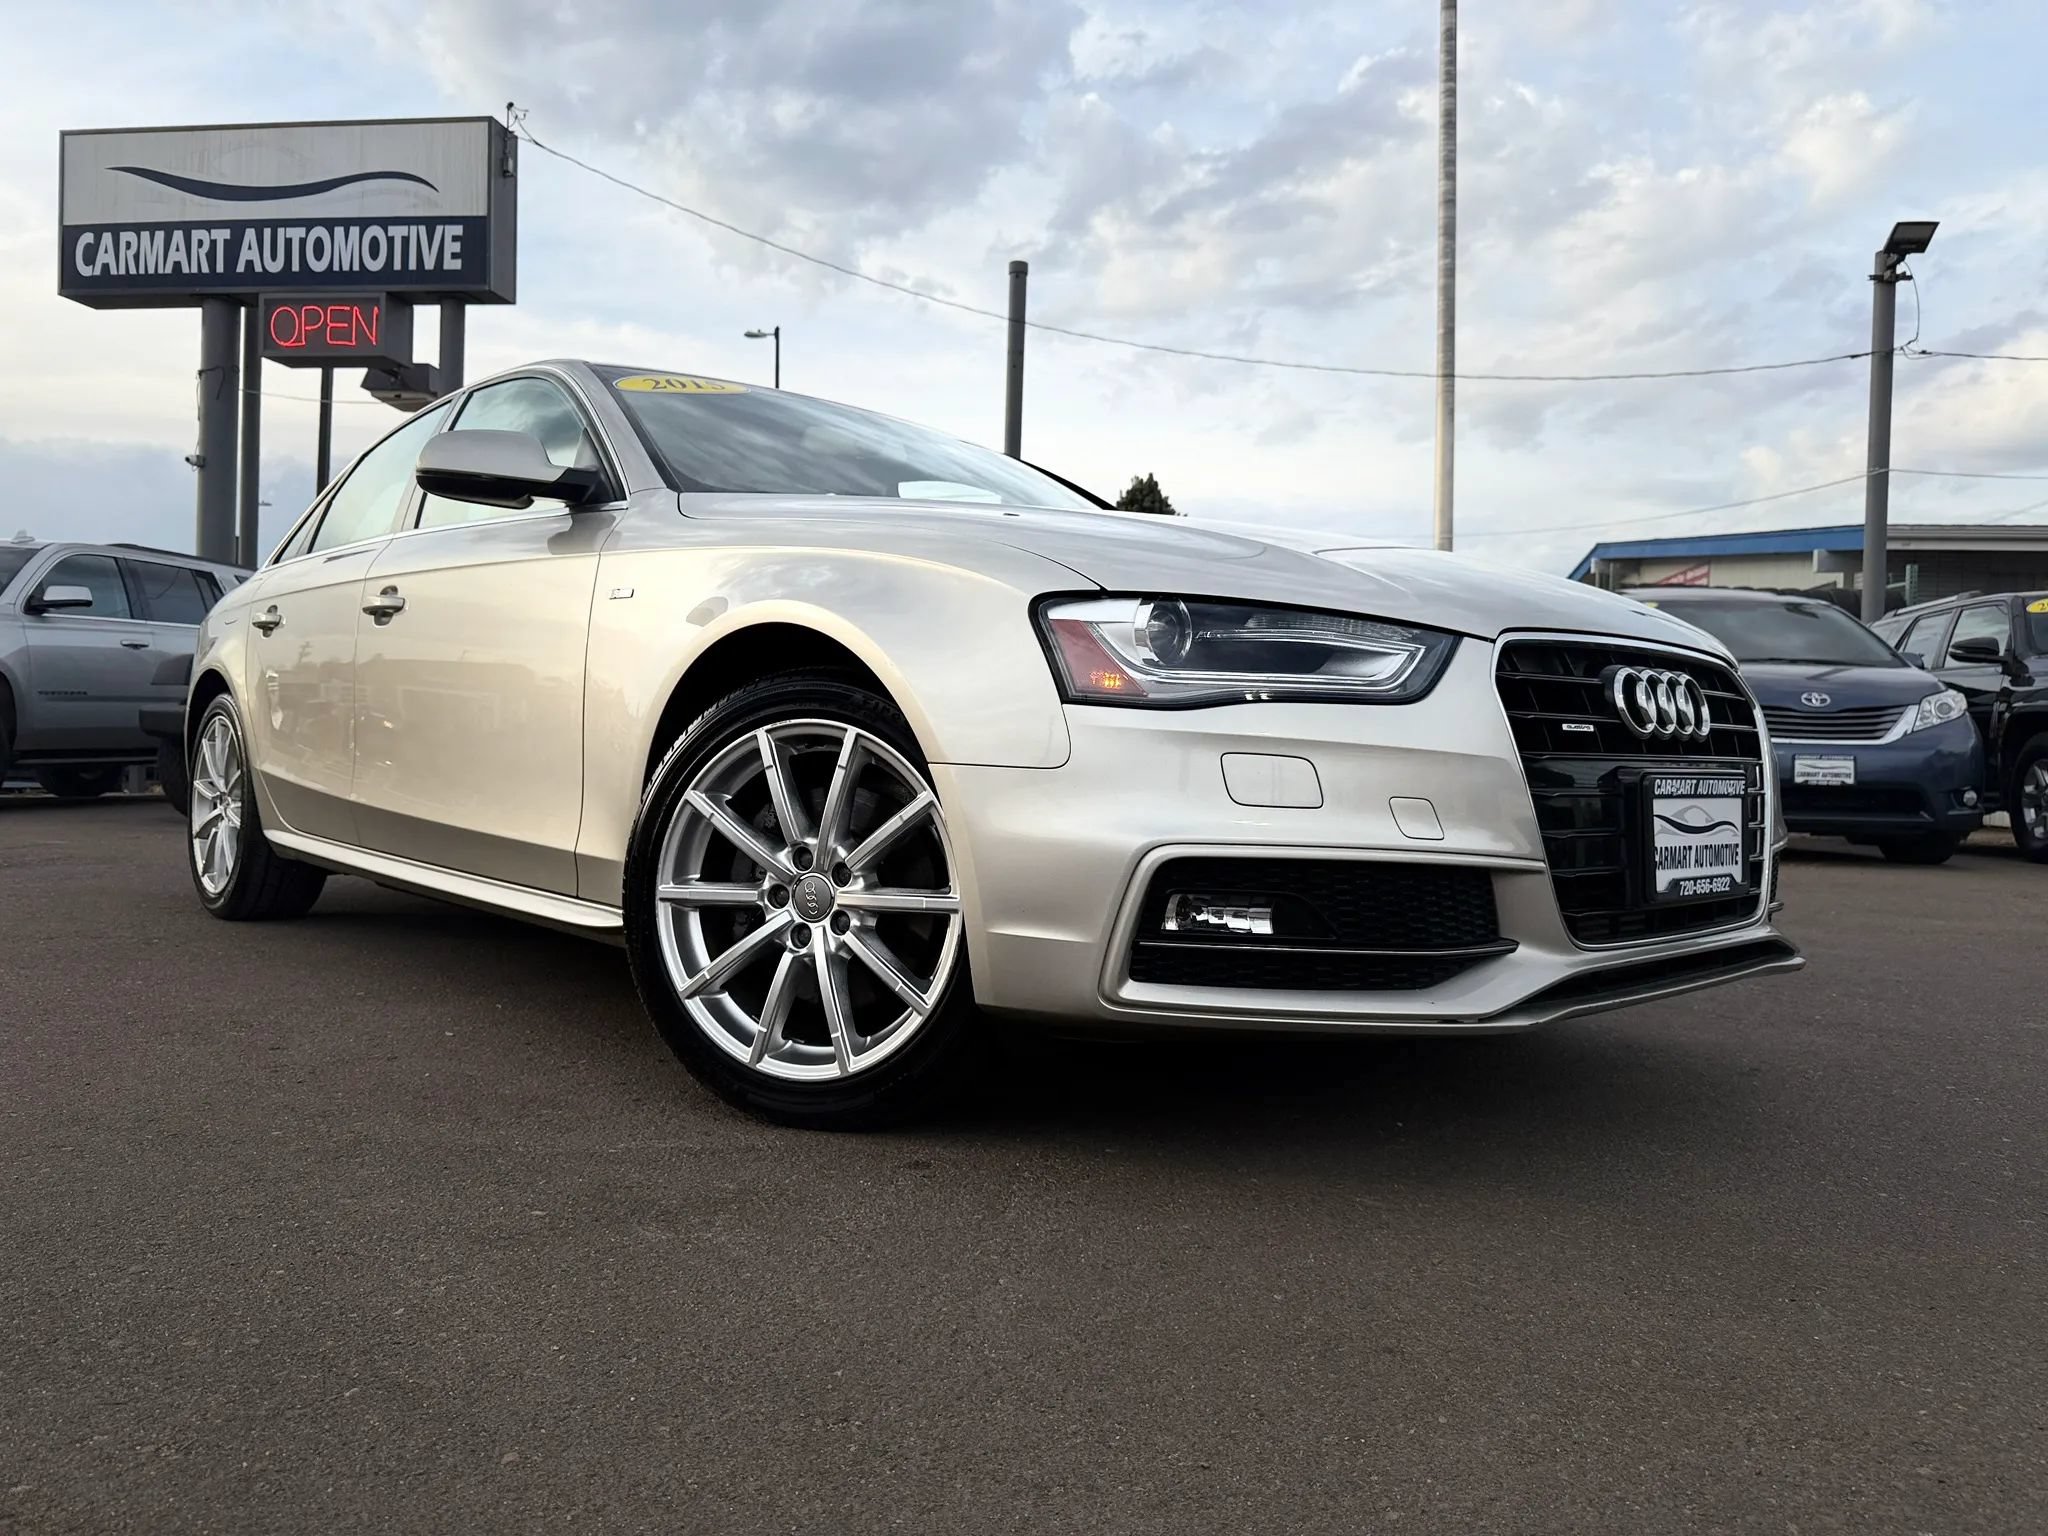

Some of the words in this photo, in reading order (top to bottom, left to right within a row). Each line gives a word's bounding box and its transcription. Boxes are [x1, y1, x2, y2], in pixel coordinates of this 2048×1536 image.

[75, 229, 231, 276] CARMART
[236, 225, 463, 273] AUTOMOTIVE
[271, 305, 378, 347] OPEN
[1654, 779, 1696, 795] CARMART
[1697, 779, 1746, 795] AUTOMOTIVE
[1694, 843, 1740, 868] AUTOMOTIVE
[1679, 877, 1730, 896] 720-656-6922
